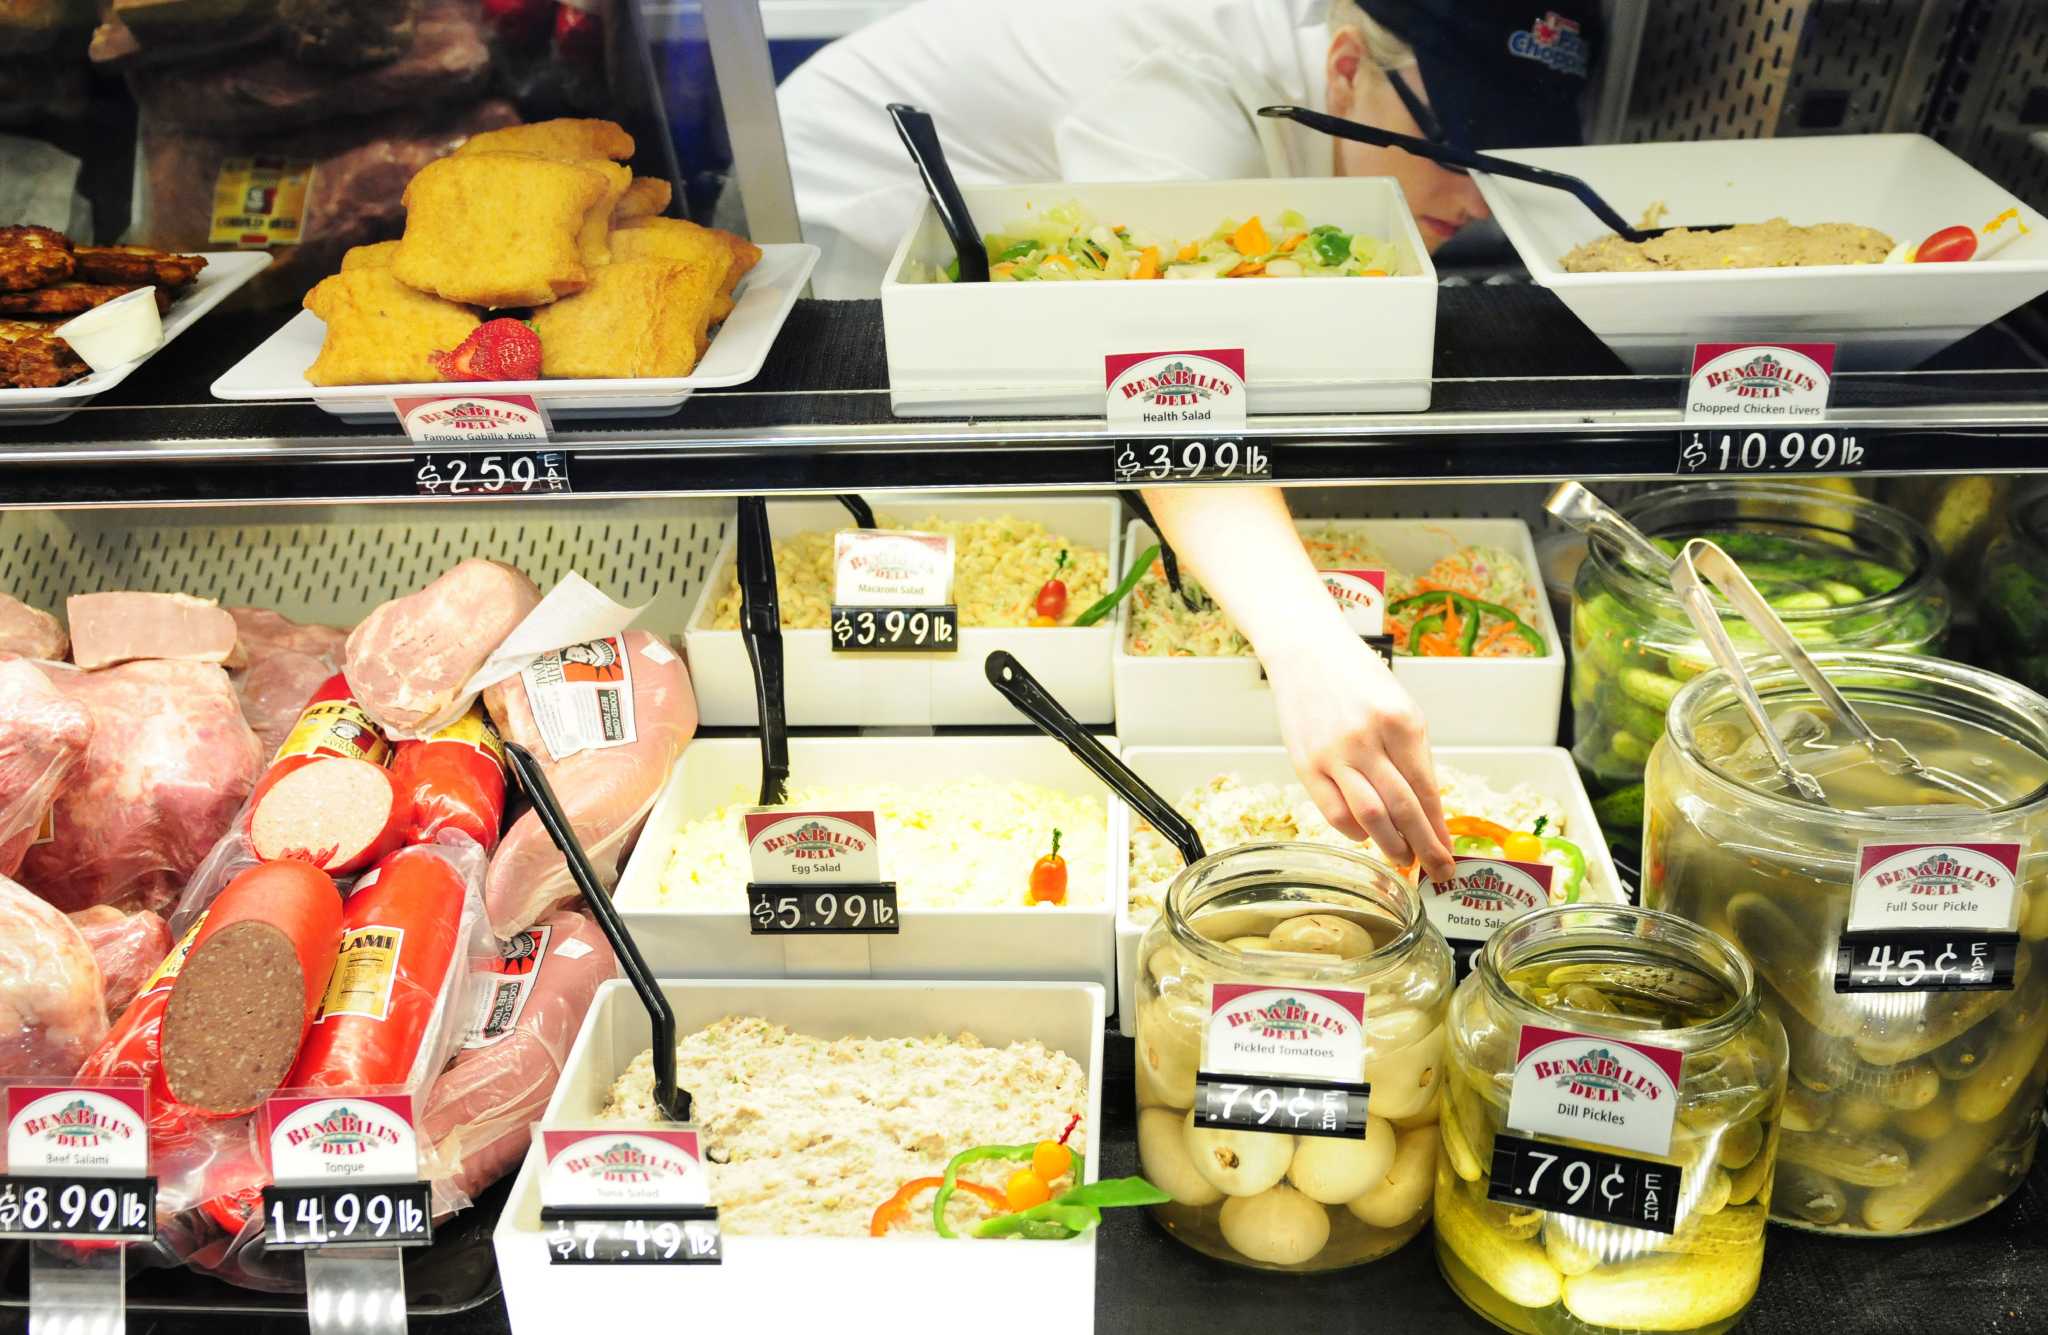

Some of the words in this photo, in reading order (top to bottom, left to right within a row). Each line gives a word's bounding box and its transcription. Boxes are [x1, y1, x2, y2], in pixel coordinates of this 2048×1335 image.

[1737, 386, 1780, 398] DELI
[1155, 393, 1199, 406] DELI
[1692, 402, 1740, 415] Chopped
[1743, 403, 1785, 415] Chicken
[1789, 405, 1821, 415] Livers
[1143, 411, 1178, 422] Health
[1182, 411, 1211, 421] Salad
[453, 420, 498, 429] DELI
[424, 433, 463, 441] Famous
[507, 432, 536, 441] Knish
[417, 455, 535, 493] $2.59
[901, 586, 924, 595] Salad
[795, 848, 836, 860] DELI
[792, 864, 811, 874] Egg
[814, 864, 841, 873] Salad
[1910, 884, 1961, 896] DELI
[1461, 896, 1503, 911] DELI
[1886, 902, 1907, 912] Full
[1912, 902, 1938, 912] Sour
[1943, 901, 1978, 912] Pickle
[1448, 913, 1481, 927] Potato
[1484, 918, 1505, 928] Sala
[339, 934, 394, 953] LAMI
[1262, 1027, 1309, 1040] DELI
[1234, 1042, 1275, 1054] Pickled
[1279, 1045, 1335, 1057] Tomatoes
[1569, 1082, 1620, 1103] DELI
[1558, 1103, 1578, 1116] Dill
[1583, 1107, 1625, 1125] Pickles
[58, 1134, 100, 1147] DELI
[322, 1141, 367, 1155] DELI
[47, 1153, 70, 1164] Beef
[325, 1162, 365, 1175] Tongue
[603, 1170, 651, 1183] DELI
